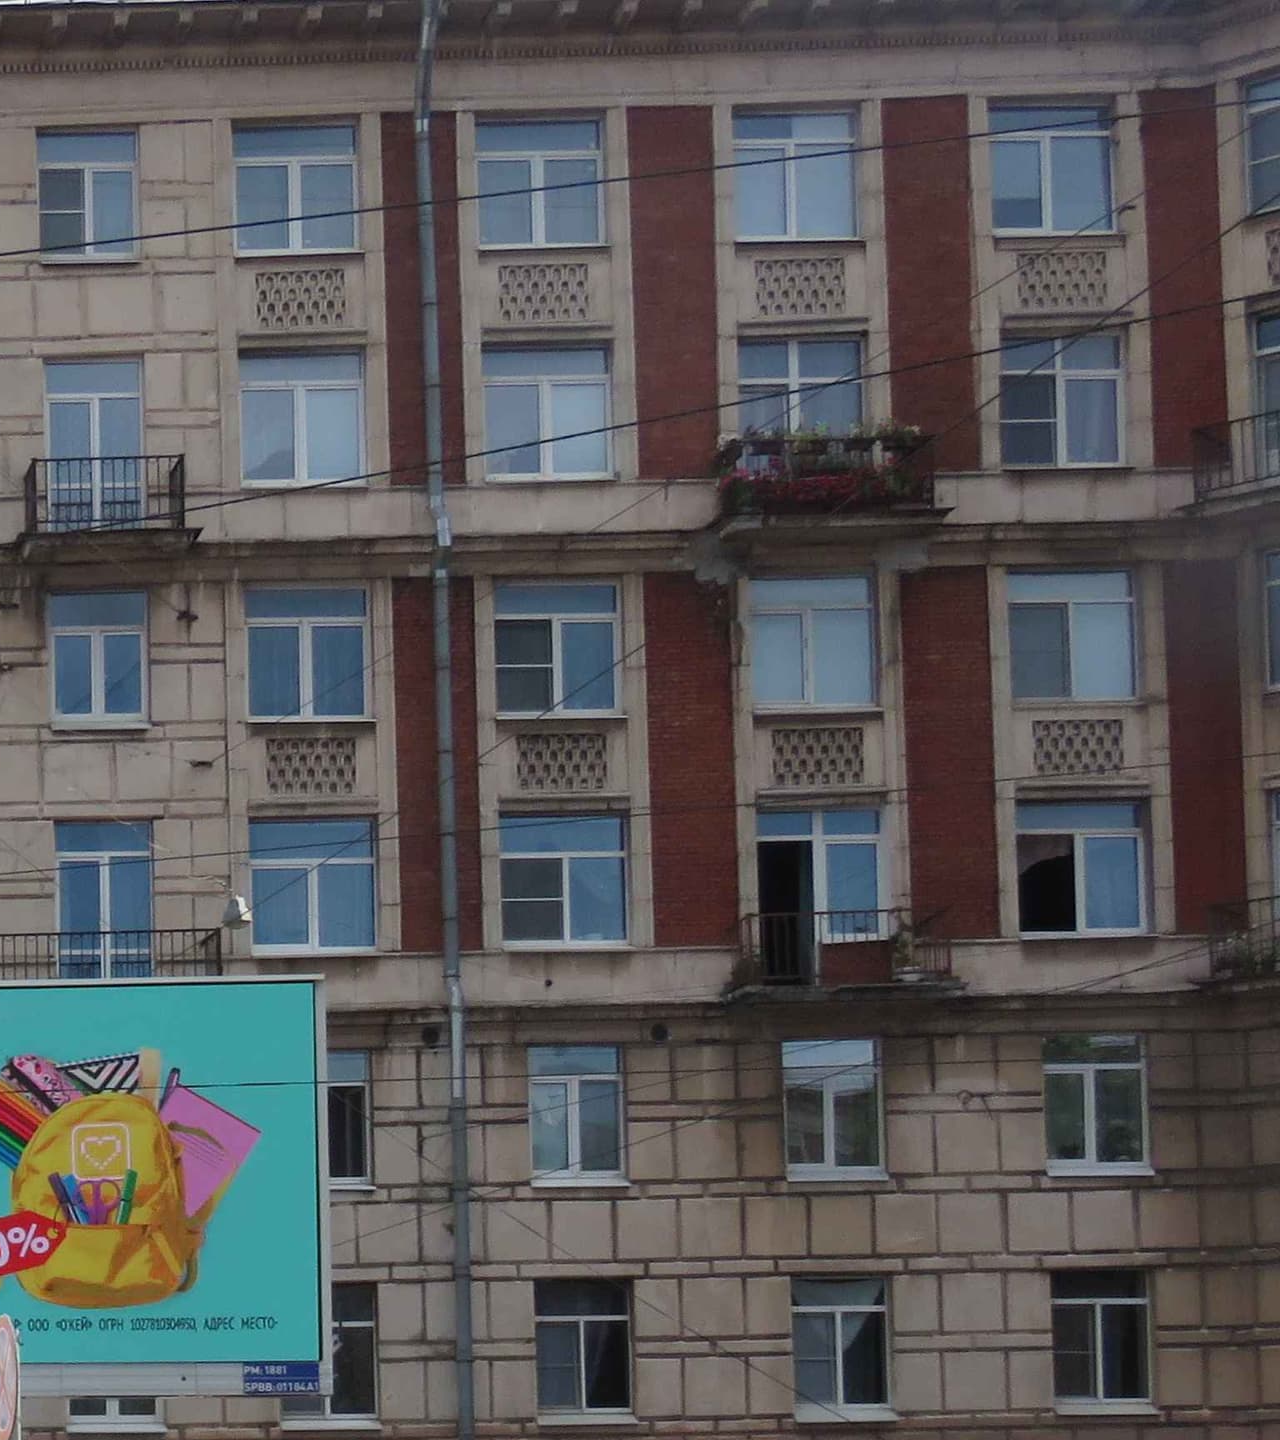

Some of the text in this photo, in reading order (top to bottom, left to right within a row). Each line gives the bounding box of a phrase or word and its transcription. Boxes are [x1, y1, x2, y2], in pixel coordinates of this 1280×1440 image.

[28, 1318, 49, 1331] ООО
[98, 1318, 124, 1331] ОГРН
[203, 1316, 236, 1330] АДРЕС
